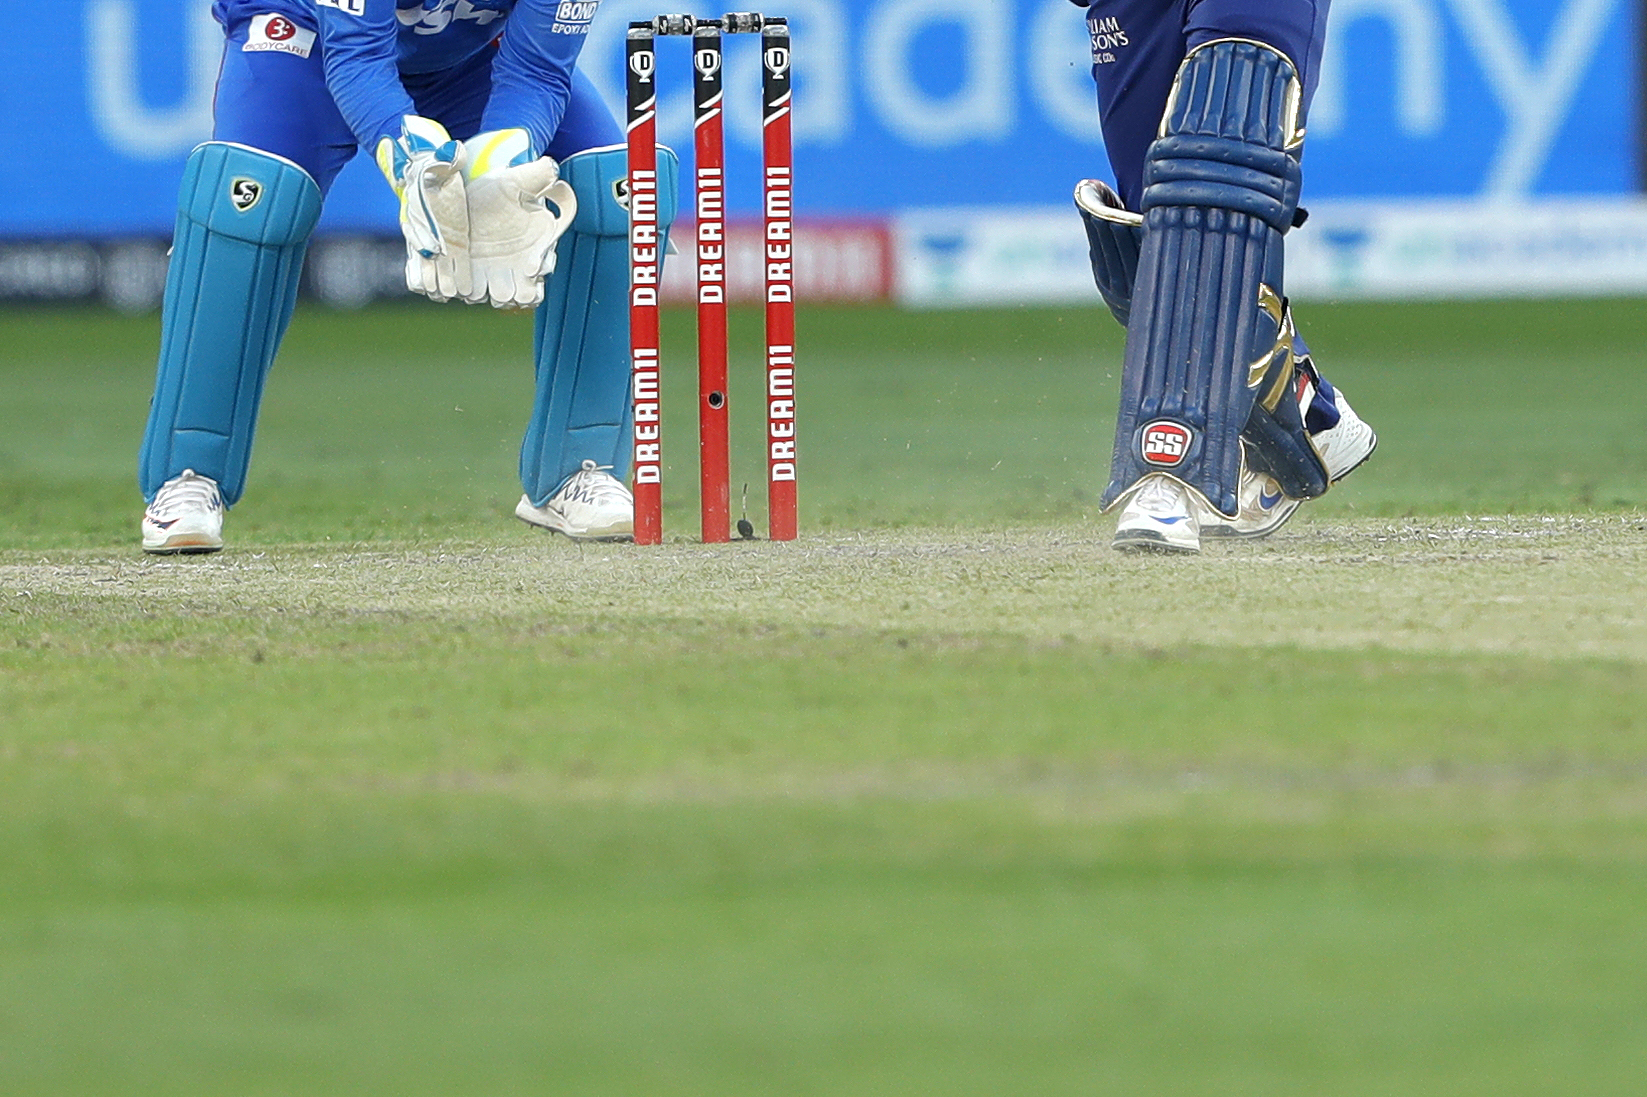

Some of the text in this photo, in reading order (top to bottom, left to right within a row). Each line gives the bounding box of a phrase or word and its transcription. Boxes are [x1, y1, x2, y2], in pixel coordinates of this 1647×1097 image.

[632, 170, 657, 307] DREAM11
[698, 168, 724, 304] DREAM11
[767, 167, 792, 303] DREAM11
[634, 348, 661, 484] DREAM11
[769, 345, 796, 481] DREAM11
[1146, 432, 1183, 456] SS
